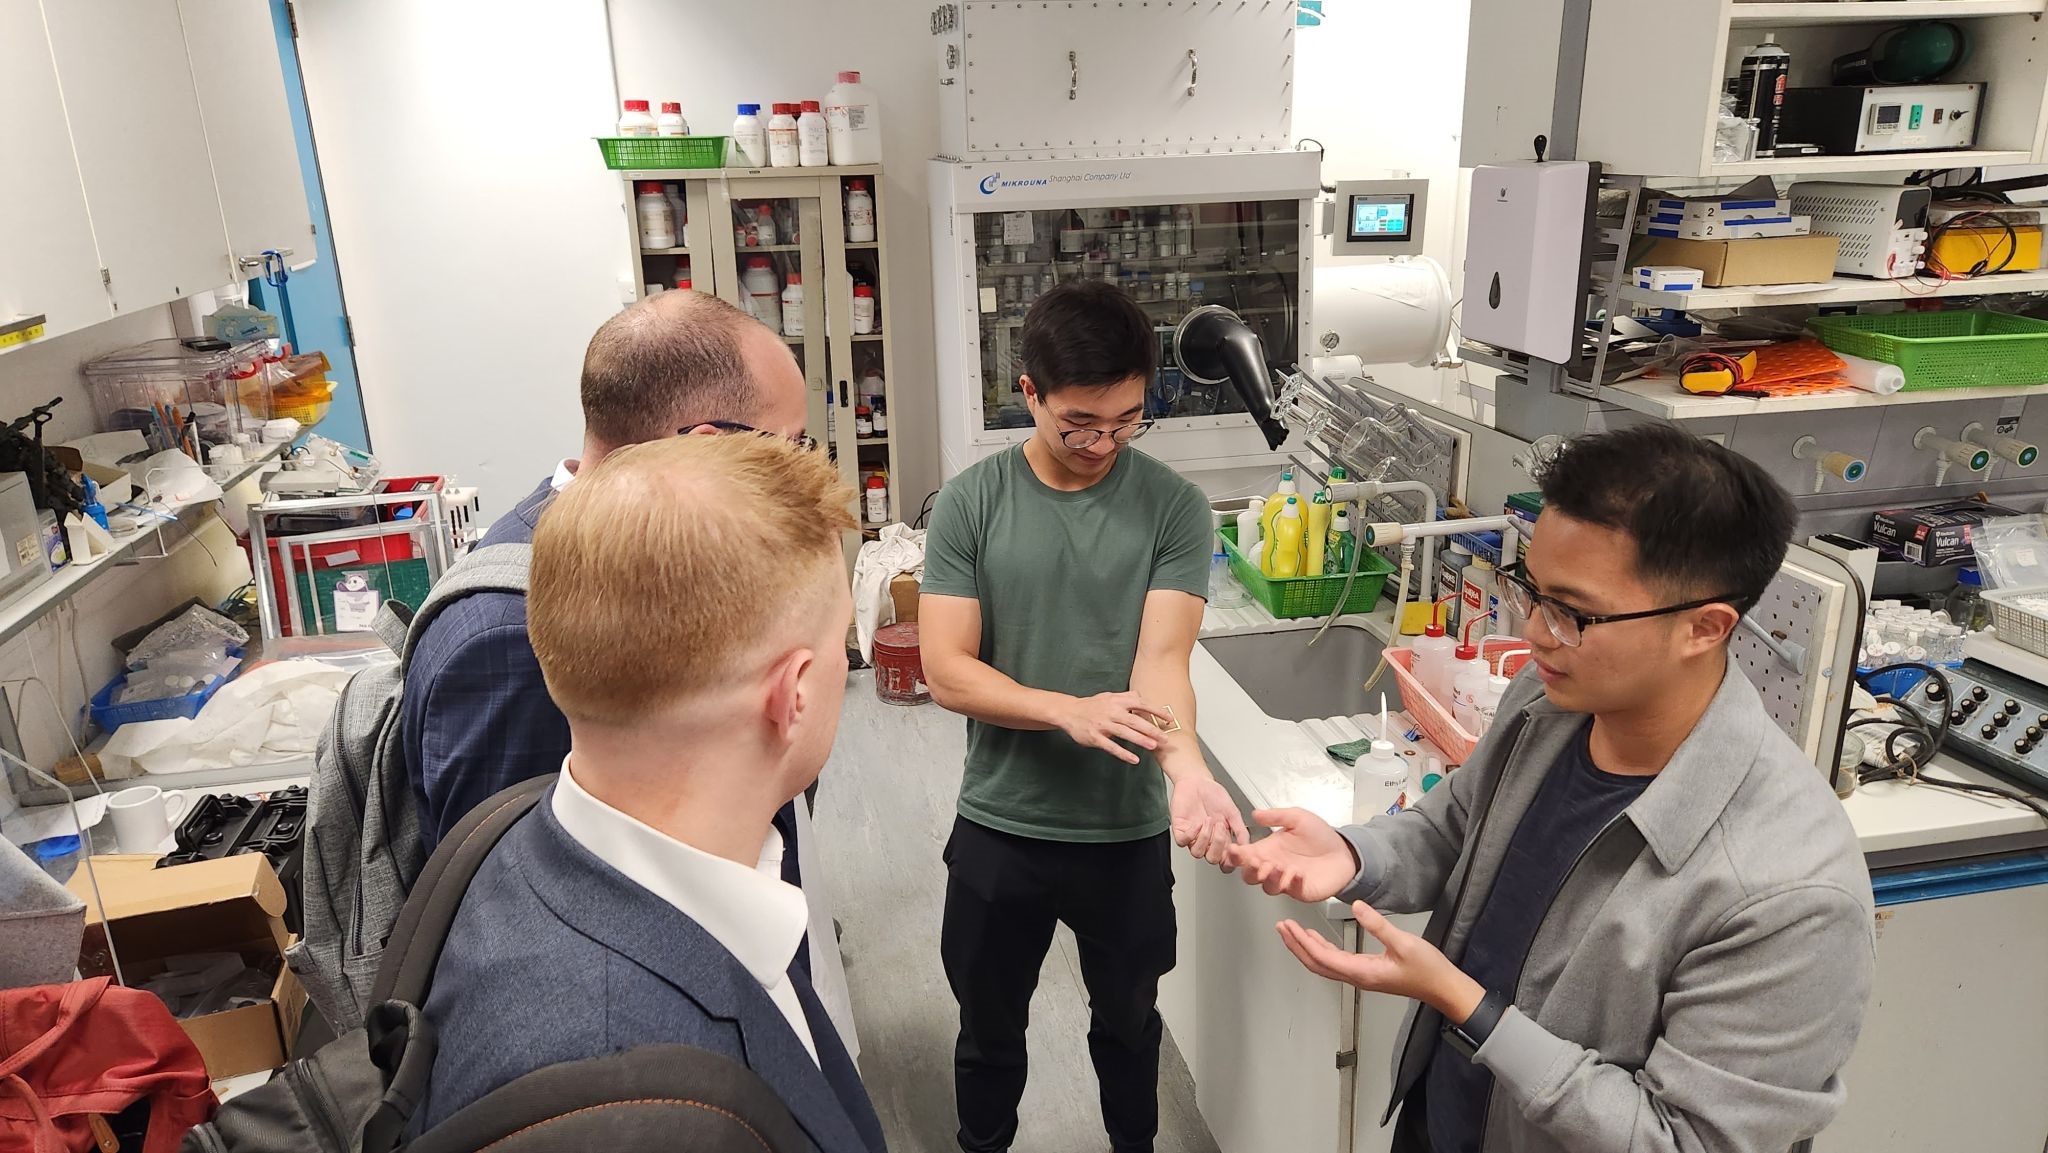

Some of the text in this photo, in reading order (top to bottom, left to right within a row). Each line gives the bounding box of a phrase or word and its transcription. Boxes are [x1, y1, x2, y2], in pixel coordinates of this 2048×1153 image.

[1001, 171, 1131, 187] MIKROUNA Shanghai Company Ltd
[1707, 207, 1715, 217] 2
[1635, 220, 1641, 229] 2
[1706, 226, 1713, 236] 2
[1873, 521, 1897, 537] Vulcan
[1936, 536, 1959, 547] Vulcan
